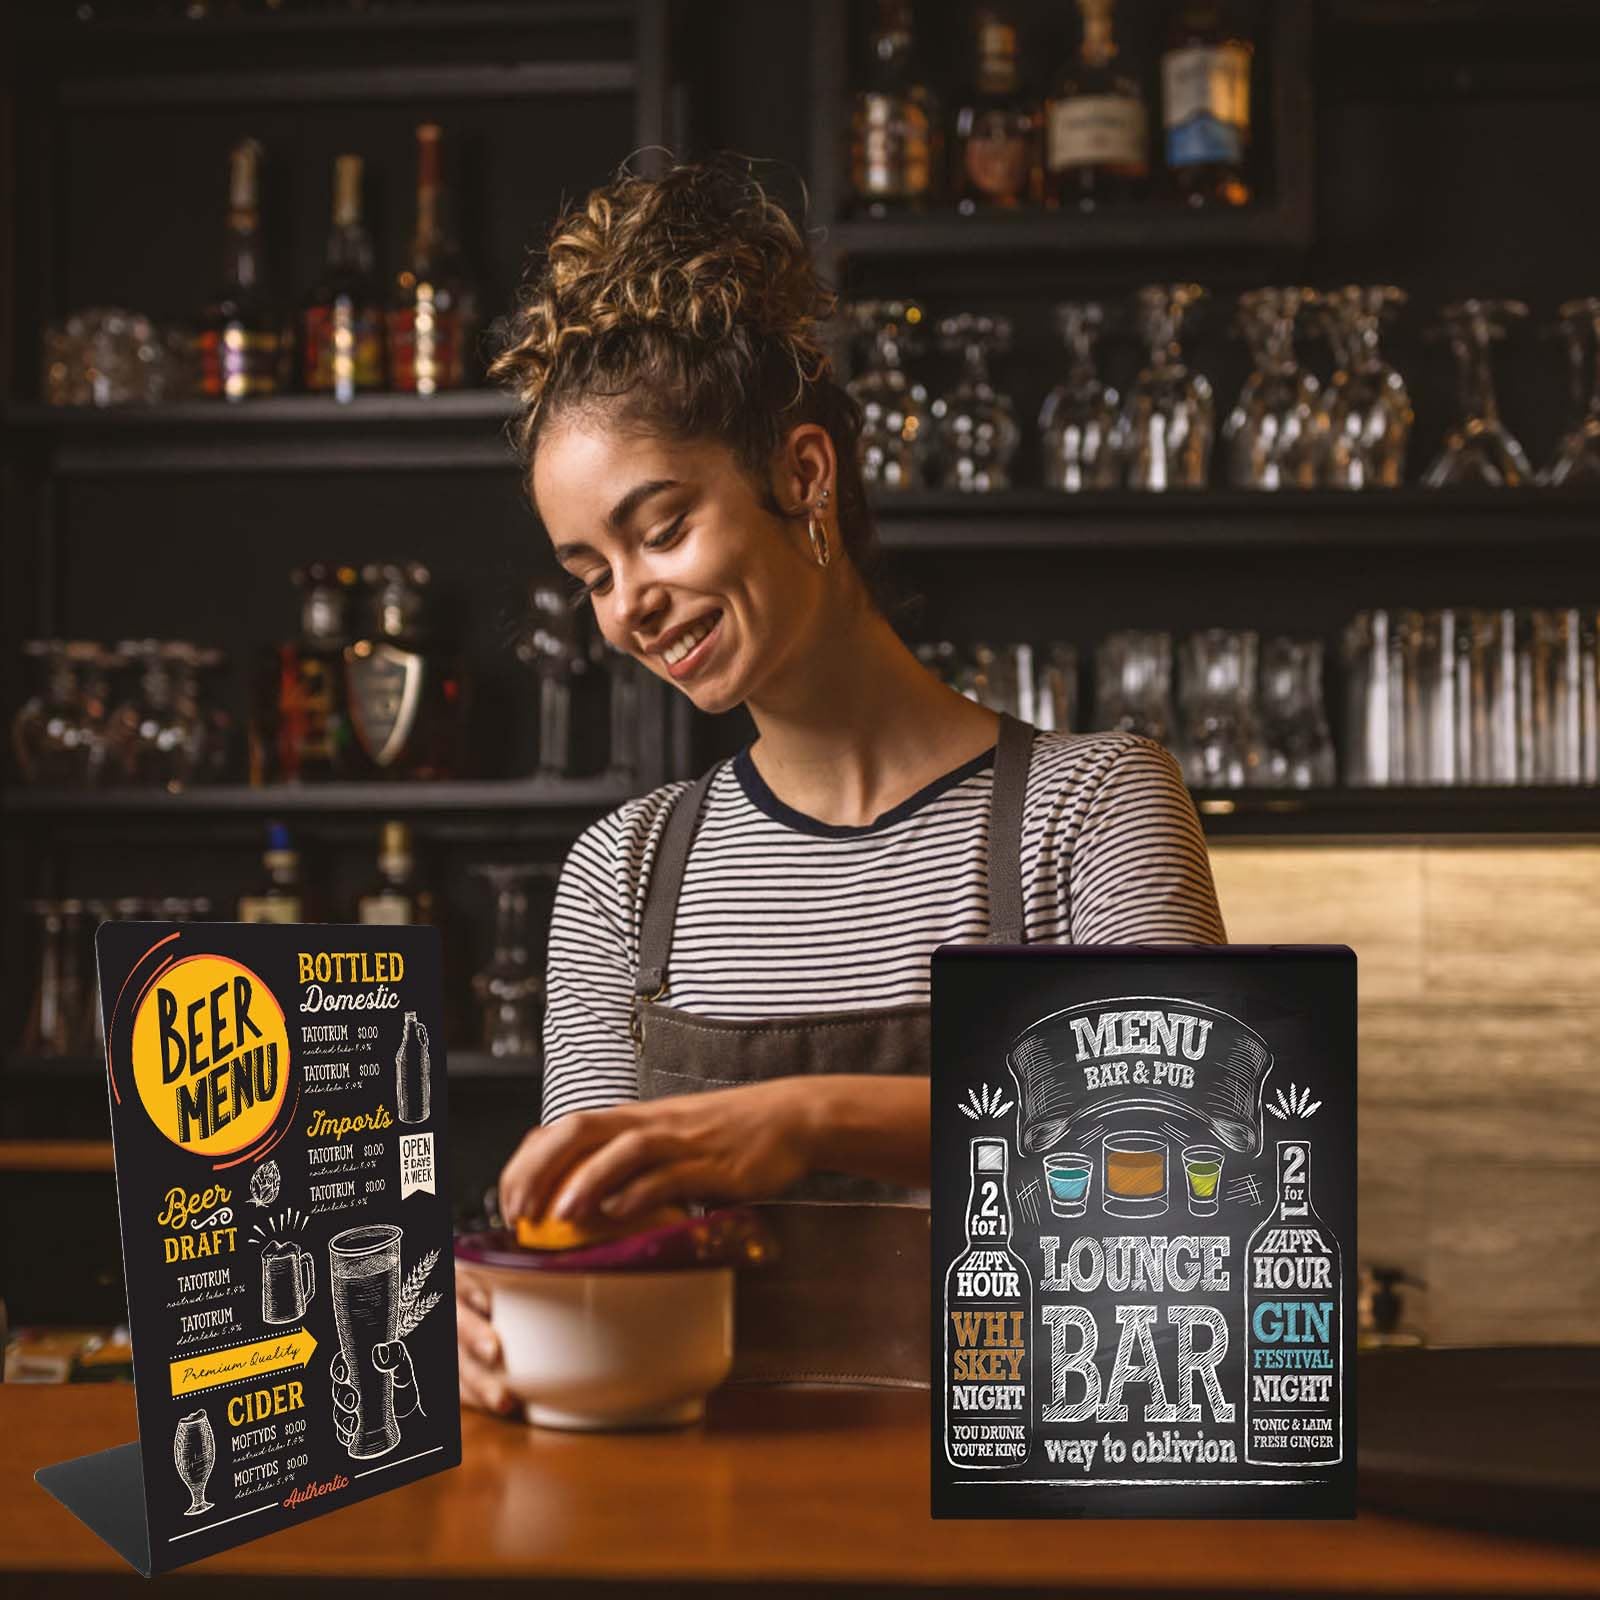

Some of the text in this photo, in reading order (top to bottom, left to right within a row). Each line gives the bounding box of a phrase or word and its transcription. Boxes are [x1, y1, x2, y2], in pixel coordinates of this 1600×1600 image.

[298, 952, 404, 984] BOTTLED
[300, 984, 400, 1013] Domestic
[157, 976, 263, 1085] BEER
[301, 1025, 378, 1042] TATOTRUM $0.00
[1069, 1010, 1214, 1062] MENU
[303, 1063, 380, 1081] TATOTRUM $0.00
[1083, 1060, 1195, 1090] BAR & PUB
[176, 1042, 278, 1143] MENU
[307, 1103, 393, 1141] Imports
[307, 1143, 384, 1165] TATOTRUM $0.00
[403, 1137, 430, 1158] OPEN
[404, 1156, 431, 1170] 5 DAYS
[404, 1168, 433, 1185] A WEEK
[1282, 1145, 1306, 1184] 2
[309, 1179, 385, 1201] TATOTRUM $0.00
[981, 1181, 999, 1217] 2
[1284, 1185, 1304, 1201] for
[157, 1183, 232, 1230] Beer
[971, 1214, 997, 1236] for
[163, 1227, 238, 1264] DRAFT
[1253, 1229, 1333, 1254] HAPPY
[958, 1251, 1017, 1271] HAPPY
[1039, 1236, 1231, 1293] LOUNGE
[1253, 1256, 1333, 1290] HOUR
[177, 1268, 231, 1293] TATOTRUM
[957, 1272, 1021, 1297] HOUR
[180, 1307, 233, 1333] TATOTRUM
[951, 1311, 1024, 1347] WHI
[1252, 1301, 1333, 1344] GIN
[182, 1343, 301, 1384] Premium Quality
[953, 1349, 1025, 1381] SKEY
[1041, 1305, 1236, 1423] BAR
[1253, 1349, 1334, 1369] FESTIVAL
[952, 1385, 1025, 1411] NIGHT
[1252, 1375, 1333, 1403] NIGHT
[227, 1381, 305, 1427] CIDER
[231, 1419, 307, 1452] MOFTYDS $0.00
[952, 1425, 1025, 1440] YOU DRUNK
[1252, 1418, 1333, 1432] TONIC & LAIM
[952, 1443, 1026, 1458] YOU'RE KING
[1043, 1430, 1238, 1472] way to oblivion
[1253, 1435, 1334, 1449] FRESH GINGER
[234, 1453, 308, 1487] MOFTYDS $0.00
[282, 1473, 350, 1509] Authentic
